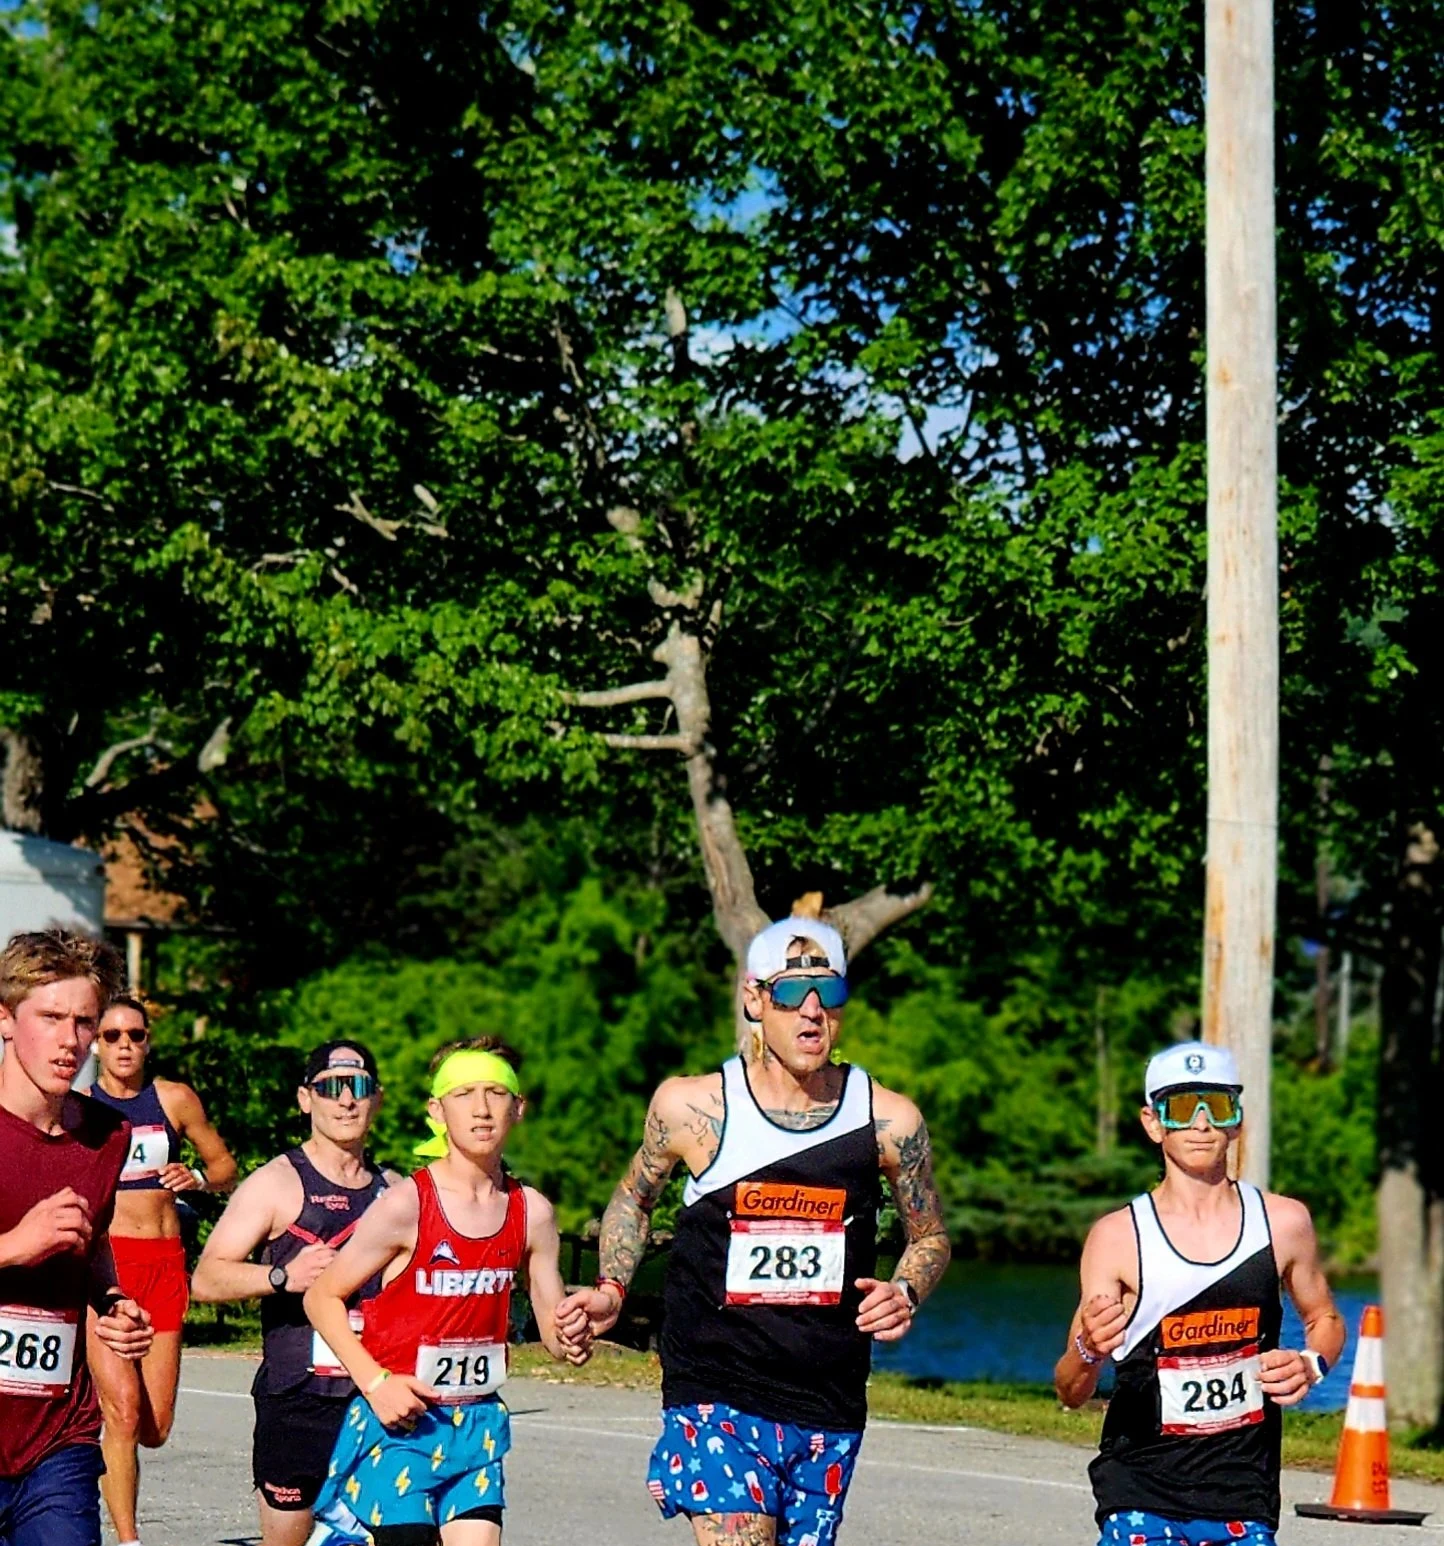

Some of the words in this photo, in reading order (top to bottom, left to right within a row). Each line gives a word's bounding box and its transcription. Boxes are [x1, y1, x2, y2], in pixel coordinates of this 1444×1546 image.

[743, 1189, 840, 1216] Gardiner
[749, 1246, 822, 1280] 283
[1168, 1314, 1255, 1342] Gardiner
[0, 1329, 61, 1372] 268
[433, 1355, 490, 1386] 219
[1182, 1371, 1247, 1413] 284
